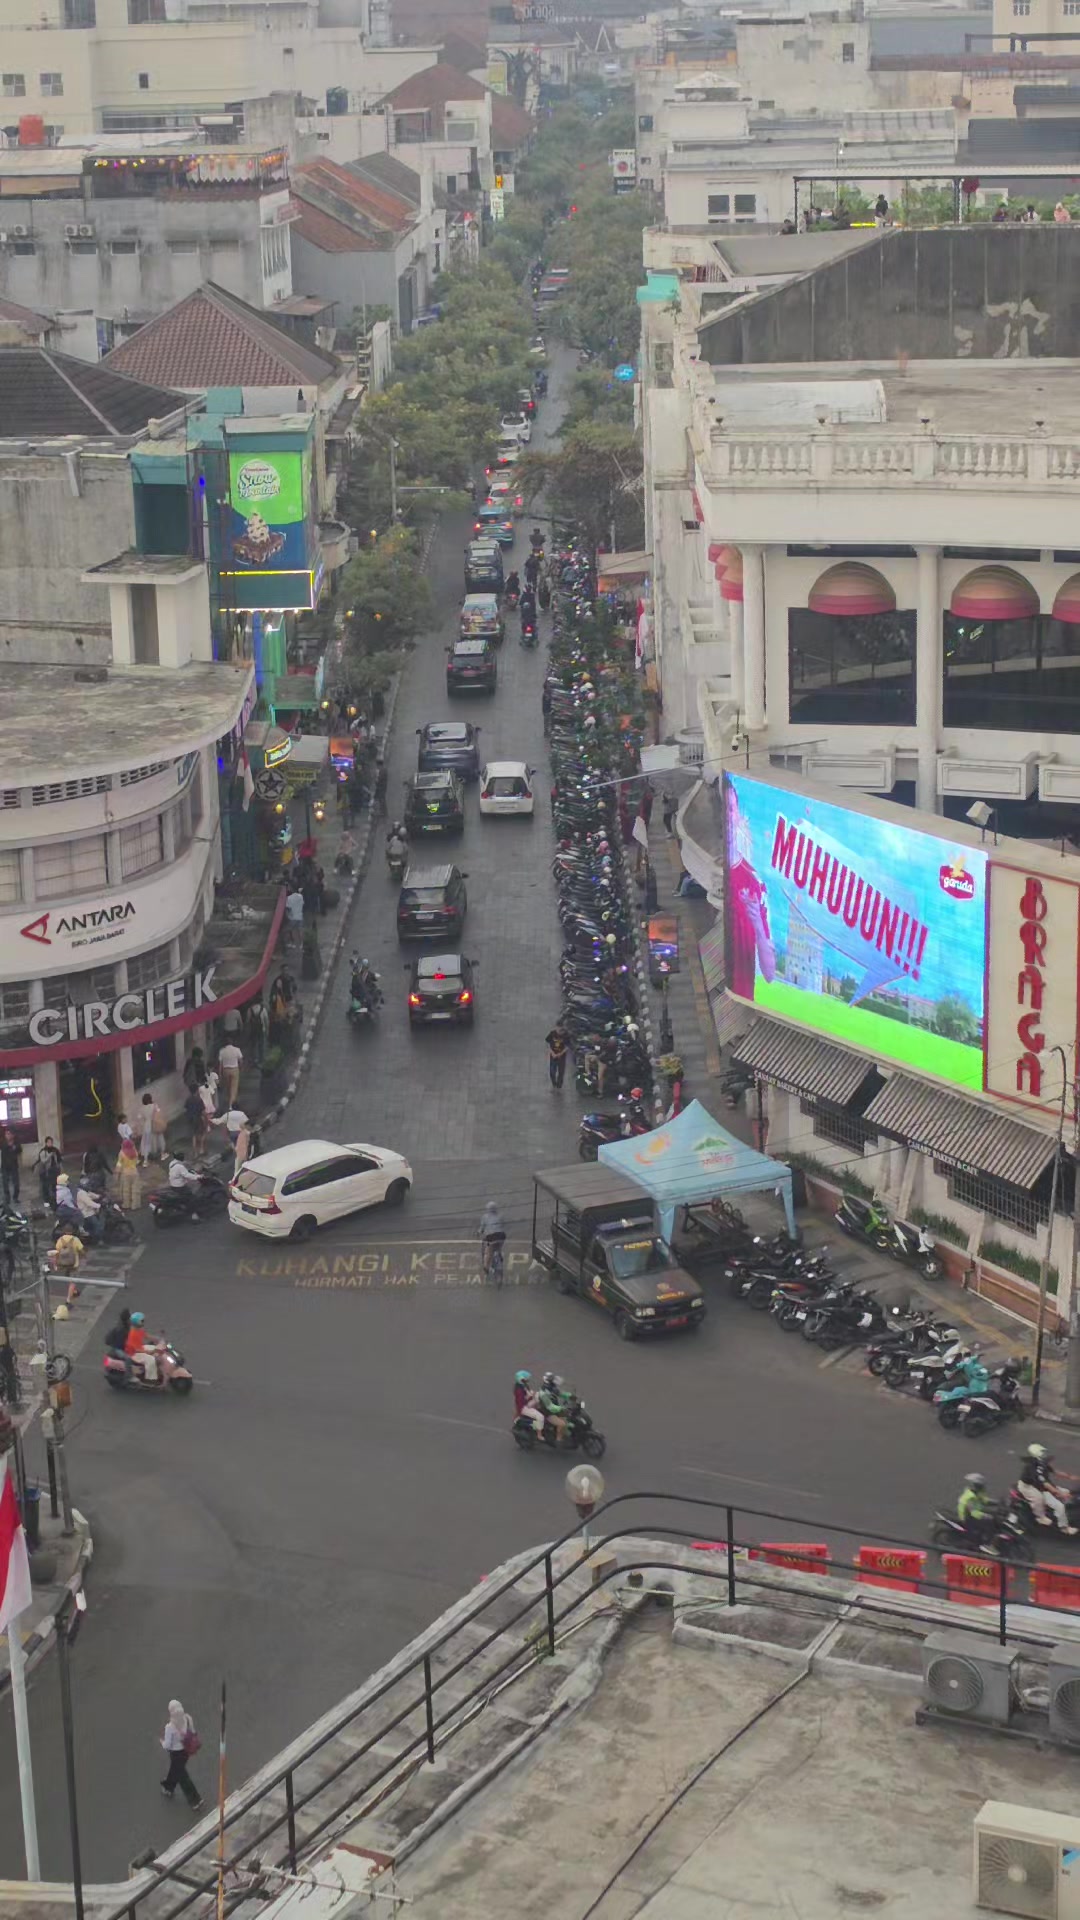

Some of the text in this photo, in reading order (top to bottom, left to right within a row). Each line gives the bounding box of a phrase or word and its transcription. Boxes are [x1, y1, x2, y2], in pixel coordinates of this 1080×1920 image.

[771, 814, 929, 982] MUHUUUN!!!
[943, 876, 973, 893] garuda
[56, 901, 136, 934] ANTARA
[29, 966, 218, 1046] CIRCLE K
[294, 1275, 372, 1288] HORMATI
[384, 1275, 420, 1285] HAK
